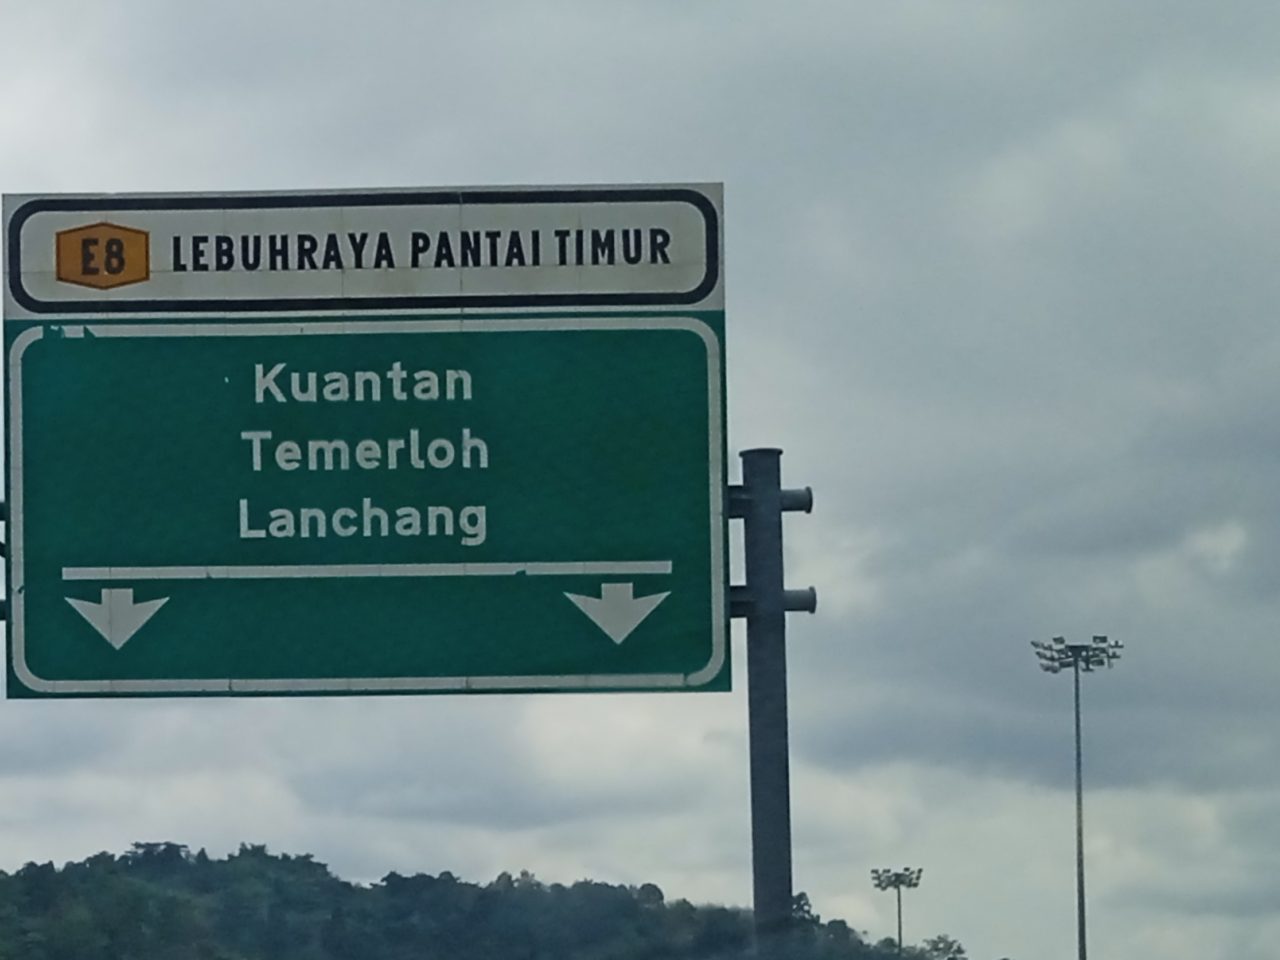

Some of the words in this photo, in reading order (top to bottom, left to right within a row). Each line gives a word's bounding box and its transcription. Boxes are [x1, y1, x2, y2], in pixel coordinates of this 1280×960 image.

[81, 238, 125, 275] E8
[173, 232, 395, 272] LEBUHRAYA
[411, 230, 540, 268] PANTAI
[555, 229, 670, 266] TIMUR
[256, 362, 472, 403] Kuantan
[241, 428, 488, 471] Temerloh
[240, 498, 486, 546] Lanchang
